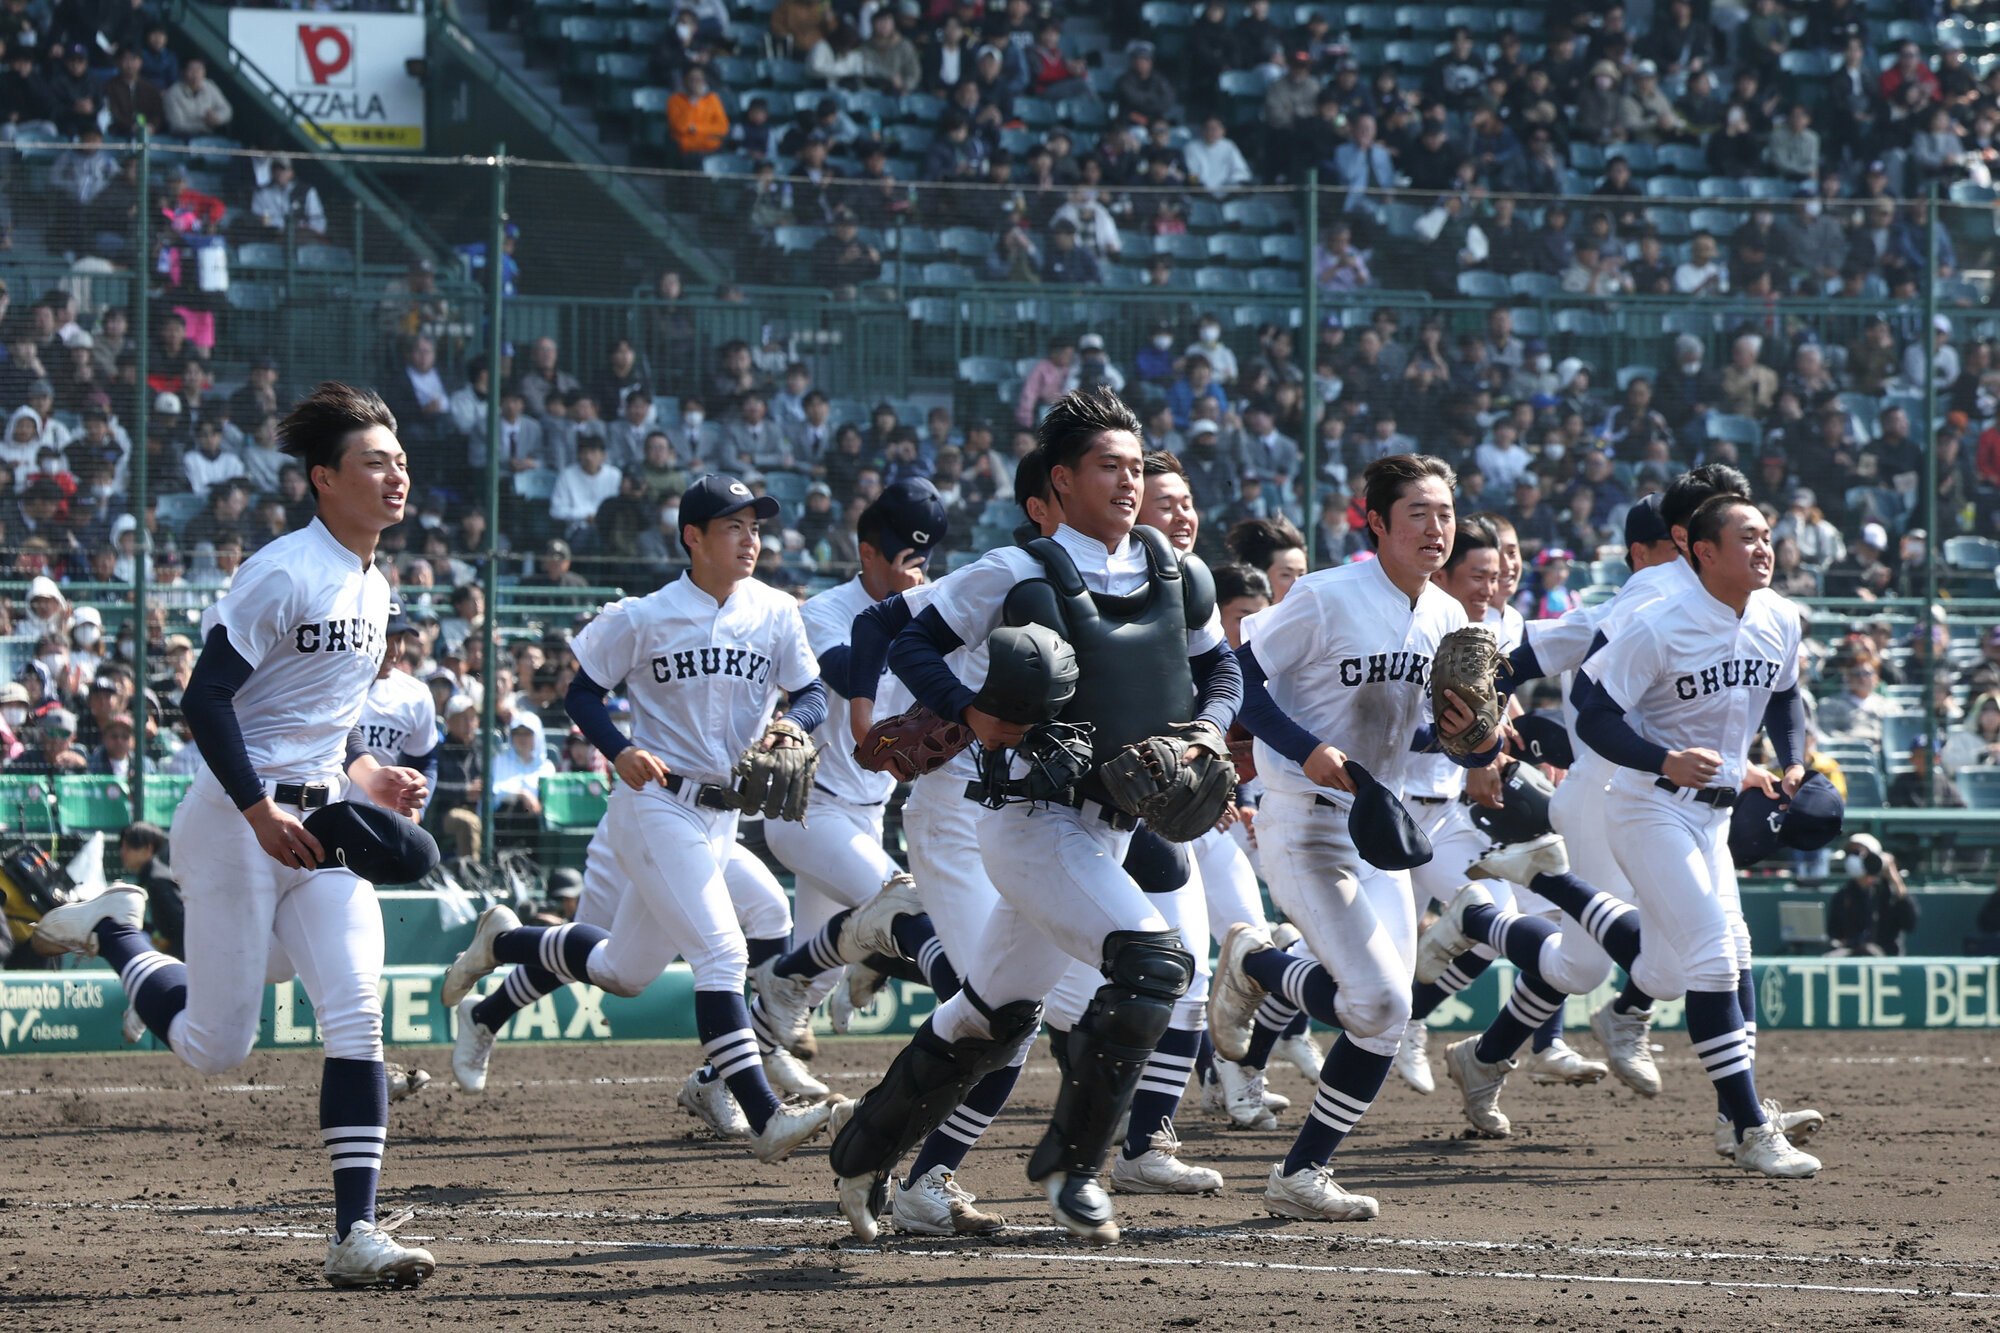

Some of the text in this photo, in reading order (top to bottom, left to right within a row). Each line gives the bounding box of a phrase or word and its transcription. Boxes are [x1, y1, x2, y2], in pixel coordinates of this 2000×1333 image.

[1339, 652, 1432, 699] CHUK
[63, 980, 104, 1008] Packs
[1788, 964, 1905, 1027] THE
